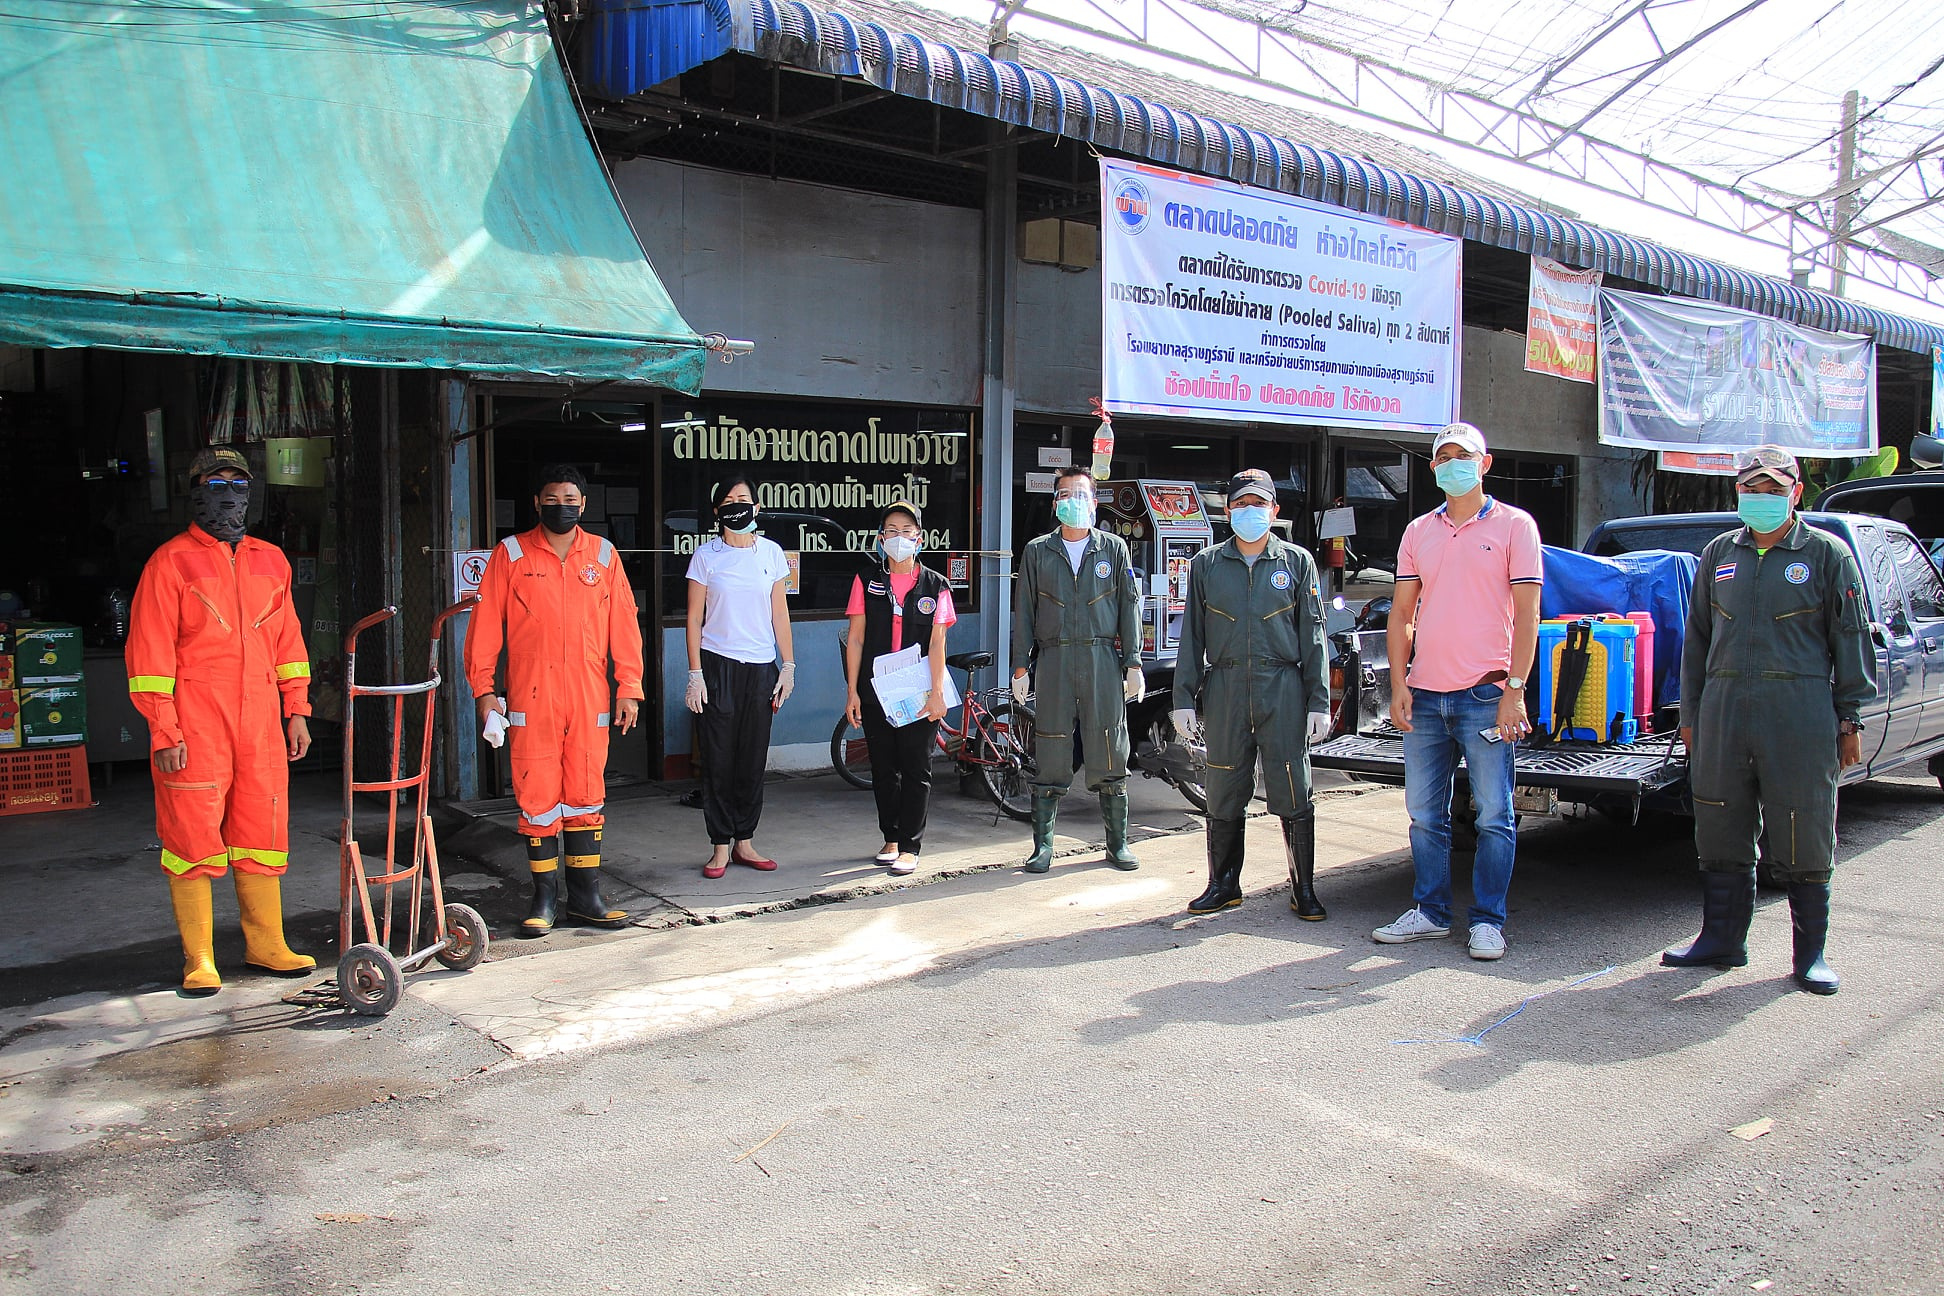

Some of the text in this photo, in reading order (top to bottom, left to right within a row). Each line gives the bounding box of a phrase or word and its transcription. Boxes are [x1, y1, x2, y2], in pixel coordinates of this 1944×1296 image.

[1164, 201, 1417, 272] ตลาดปลอดภัย ห่างไกลโควิด
[1178, 251, 1402, 311] ตลาดนี้ได้รับการตรวจ Covid-19 เชิงรุก
[1110, 282, 1451, 345] การตรวจโควิดโดยใช้น้ำลาย (Pooled Saliva) ทุก 2 สัปดาห์
[1127, 333, 1235, 364] โรงพยาบาลสุราษฎร์ธานี
[1261, 330, 1326, 353] ทำการตรวจโดย
[1260, 384, 1335, 409] ปลอดภัย
[1342, 385, 1401, 414] ไร้กังวล
[673, 411, 959, 465] สำนักงานตลาดโพหวาย
[798, 523, 833, 552] โทร.
